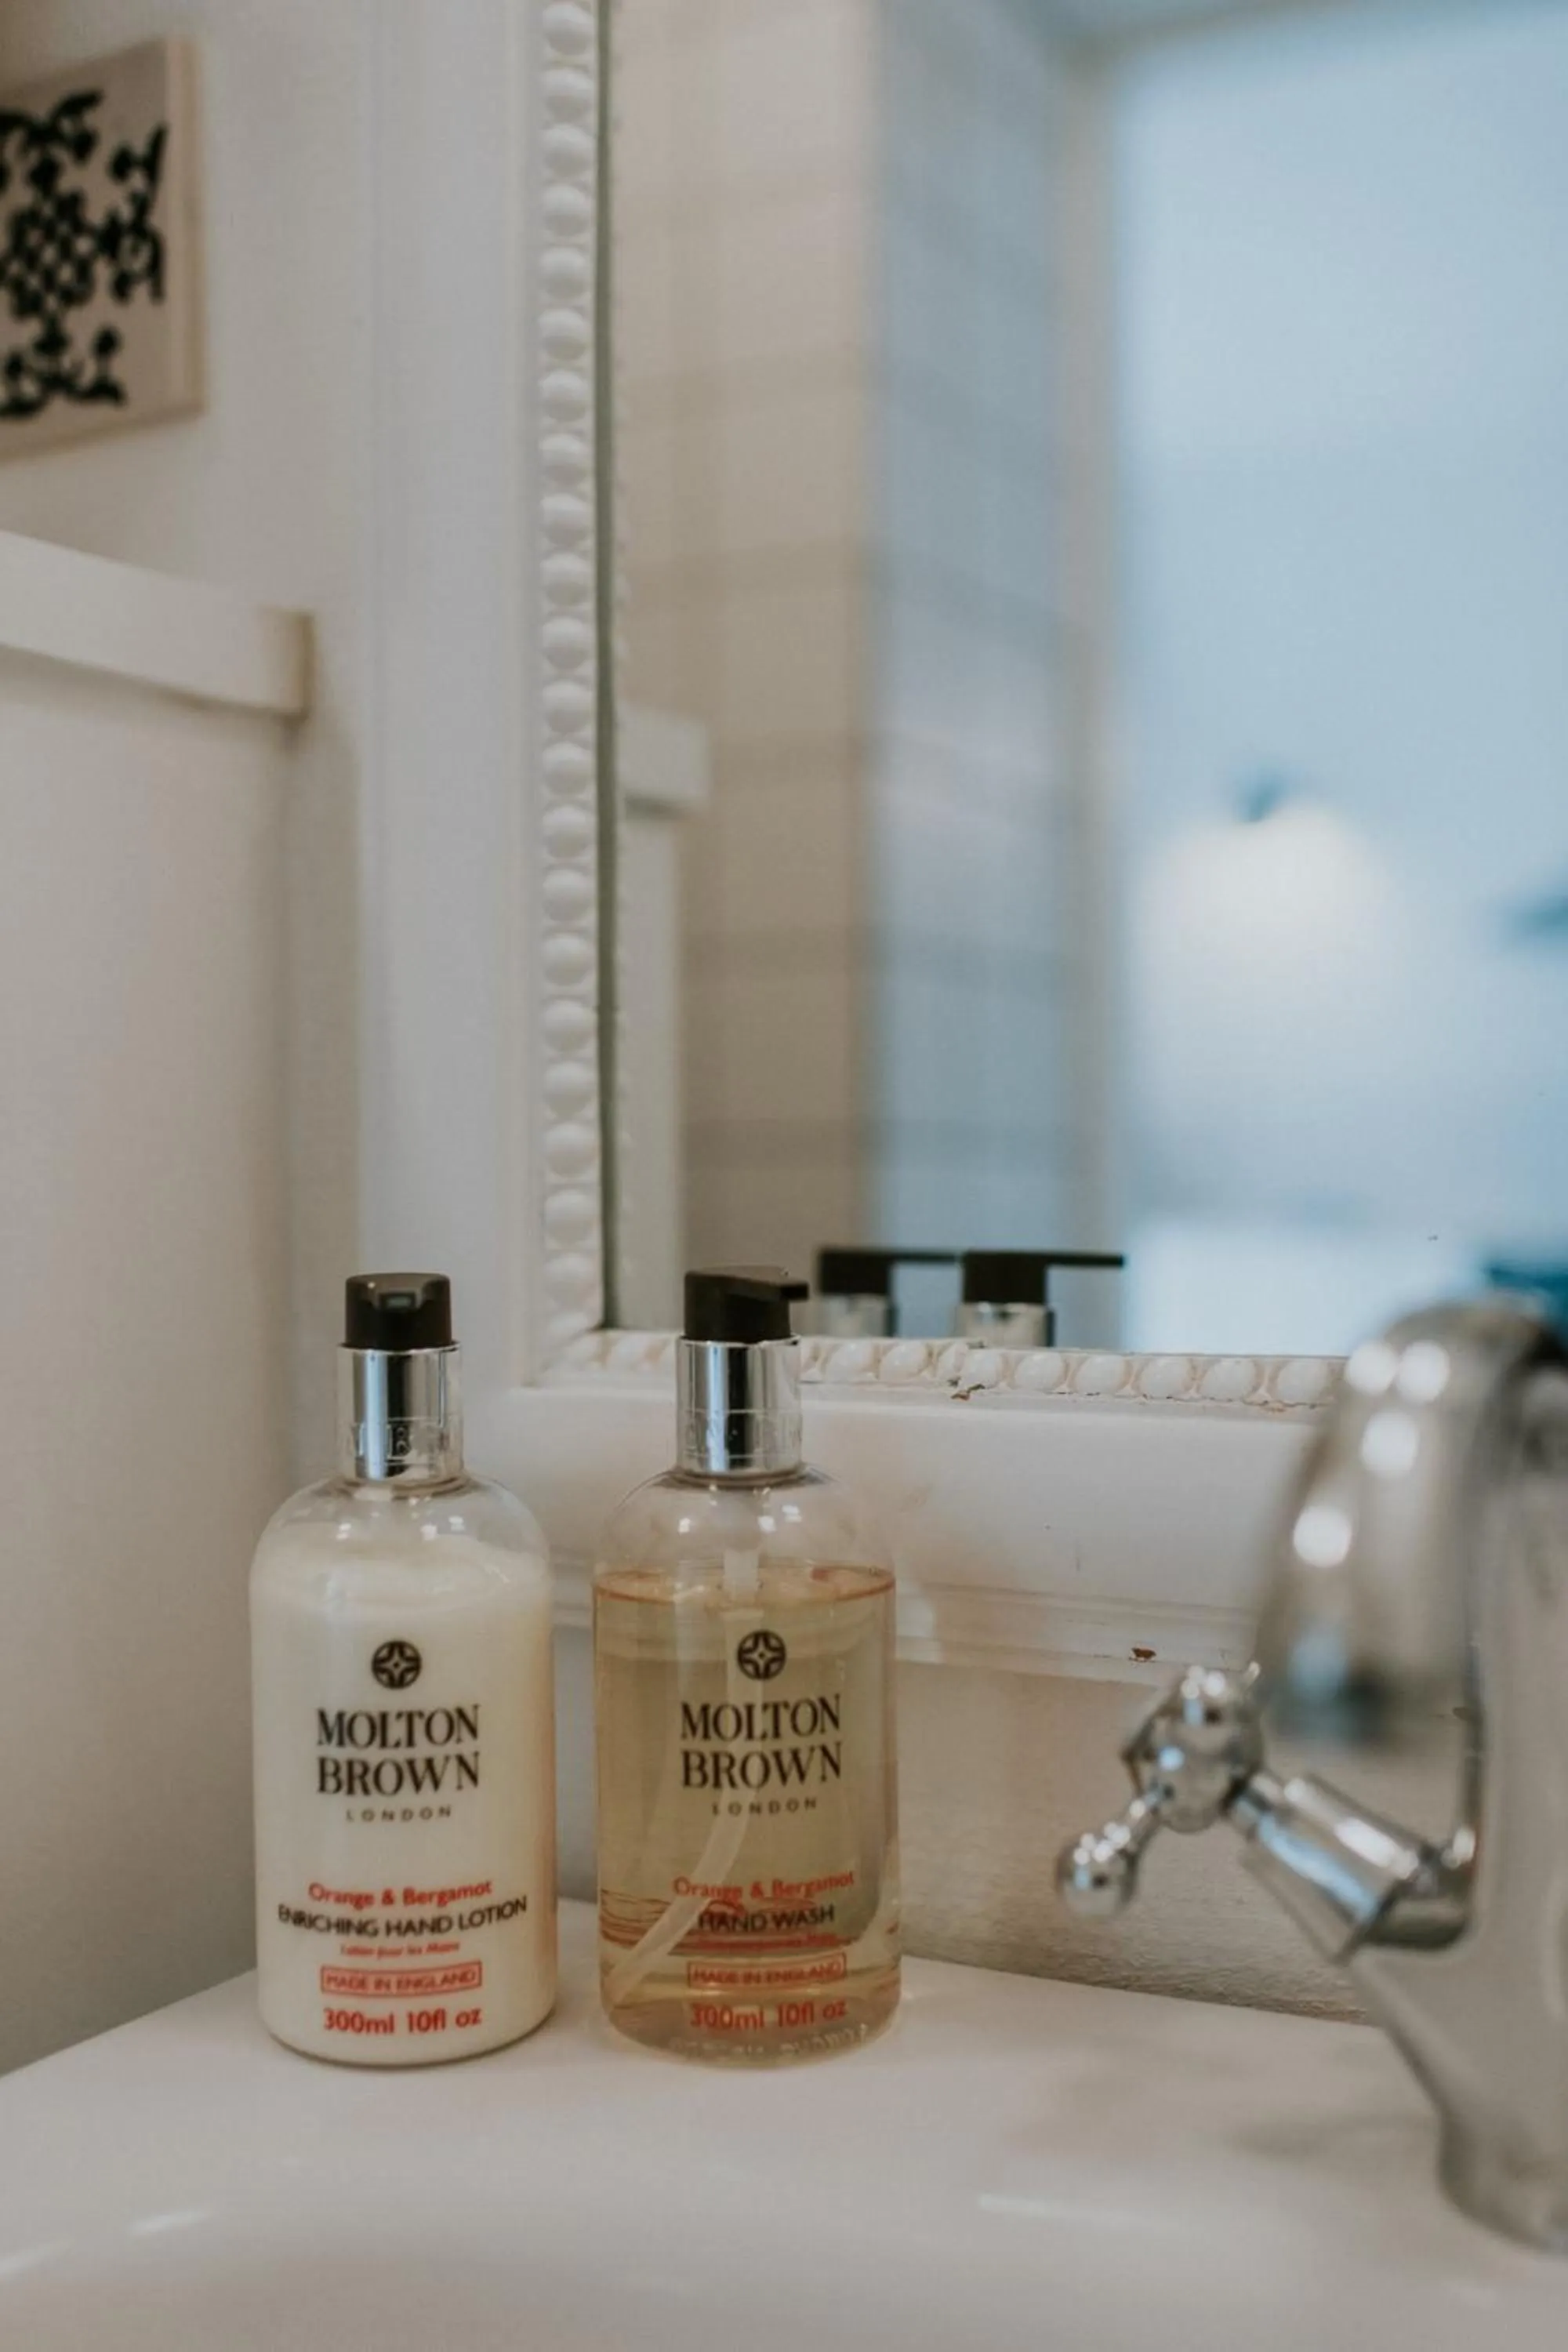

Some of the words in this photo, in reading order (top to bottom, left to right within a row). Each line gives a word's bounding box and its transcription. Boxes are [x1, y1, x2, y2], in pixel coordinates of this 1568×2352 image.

[316, 1704, 481, 1749] MOLTON
[681, 1693, 841, 1742] MOLTON
[317, 1751, 481, 1796] BROWN
[681, 1741, 841, 1790] BROWN
[346, 1805, 452, 1823] LONDON
[711, 1797, 817, 1816] LONDON
[308, 1882, 374, 1911] Orange
[381, 1888, 395, 1907] &
[403, 1880, 493, 1907] Bergamot
[278, 1903, 379, 1937] ENRICHING
[385, 1917, 453, 1938] HAND
[458, 1894, 528, 1925] LOTION
[698, 1910, 768, 1933] HAND
[772, 1904, 835, 1931] WASH
[325, 1972, 368, 1991] MADE
[373, 1976, 391, 1991] IN
[324, 2007, 394, 2034] 300ml
[407, 2008, 447, 2034] 10fl
[455, 2008, 481, 2029] oz
[822, 2001, 848, 2021] oz
